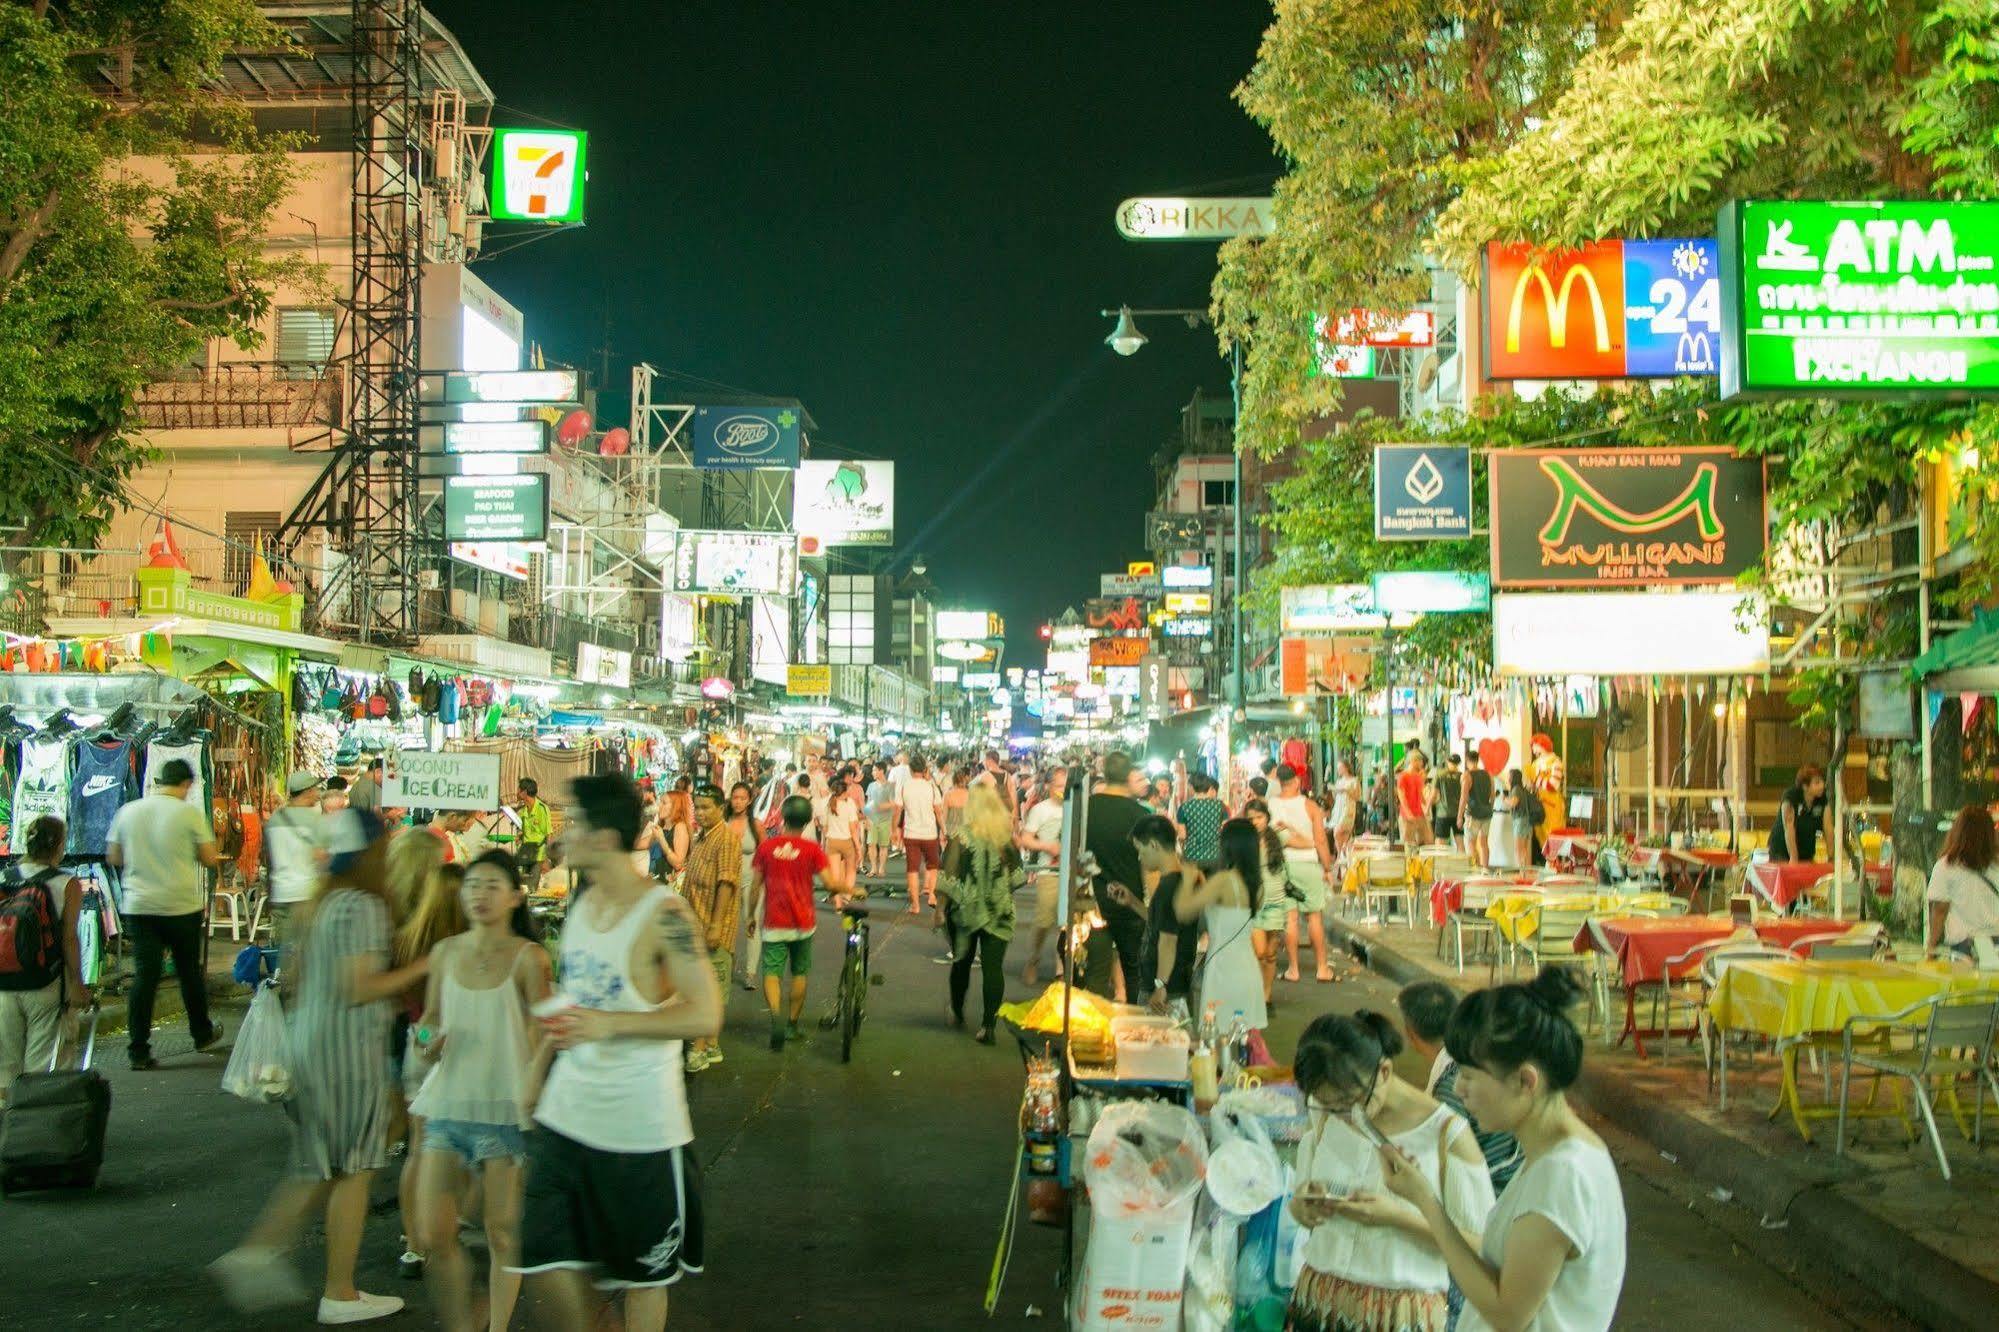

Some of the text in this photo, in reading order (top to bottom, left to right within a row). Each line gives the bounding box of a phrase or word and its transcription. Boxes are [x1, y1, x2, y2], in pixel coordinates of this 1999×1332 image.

[1823, 219, 1956, 273] ATM
[1649, 278, 1721, 334] 24
[722, 422, 769, 447] Boots
[721, 456, 739, 464] health
[746, 457, 765, 465] beauty
[1383, 514, 1467, 531] Bangkok Bank
[1541, 541, 1726, 566] MULLIGANS
[90, 775, 117, 787] NIKE
